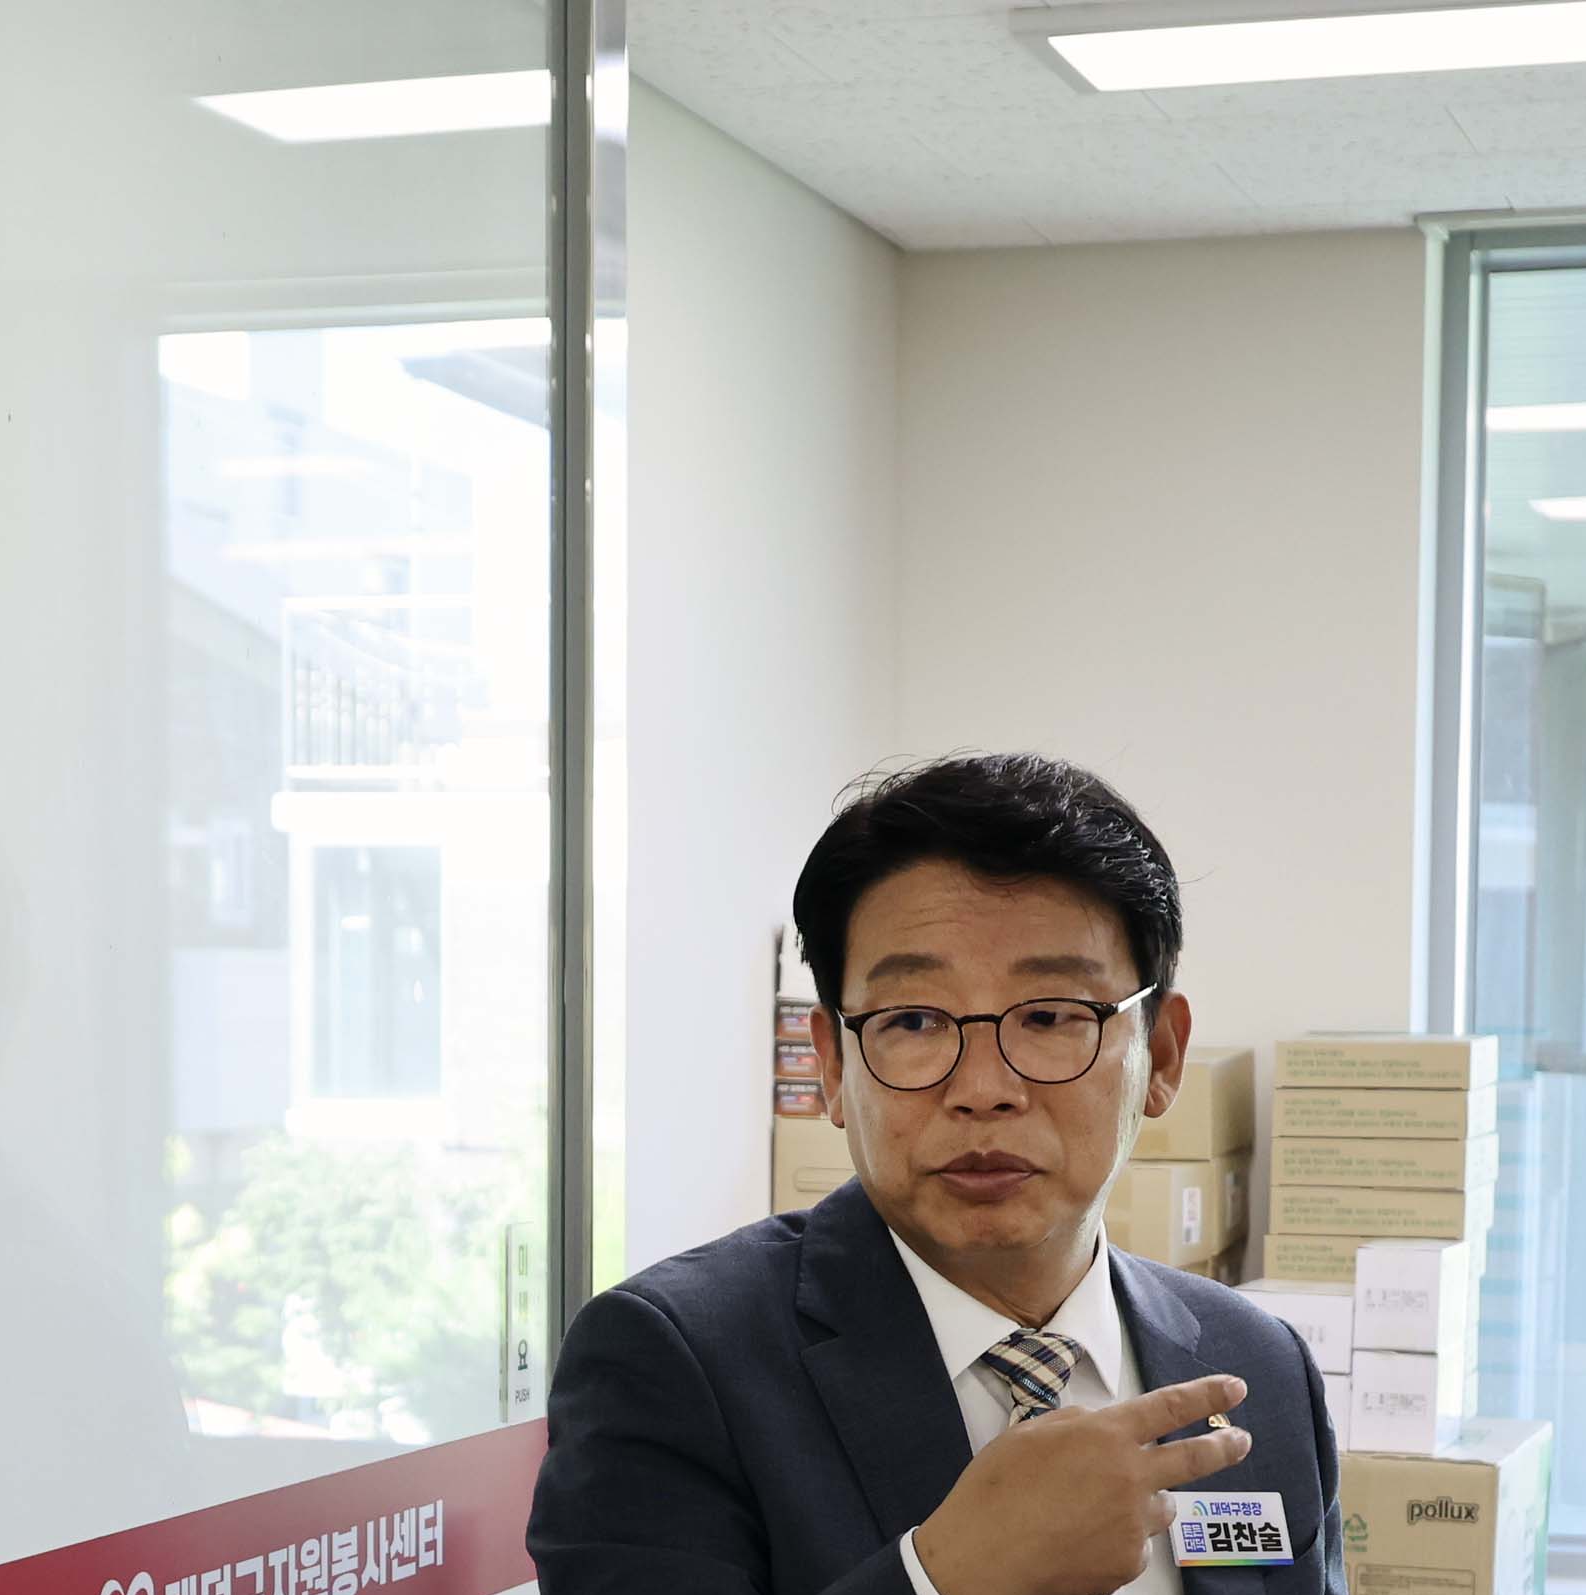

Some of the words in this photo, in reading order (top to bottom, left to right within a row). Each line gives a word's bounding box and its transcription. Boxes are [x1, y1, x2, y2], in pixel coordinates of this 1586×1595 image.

[515, 1388, 530, 1405] PUSH
[1209, 1502, 1262, 1516] 대덕구청장
[1408, 1497, 1479, 1524] pollux
[1206, 1522, 1283, 1553] 김찬술
